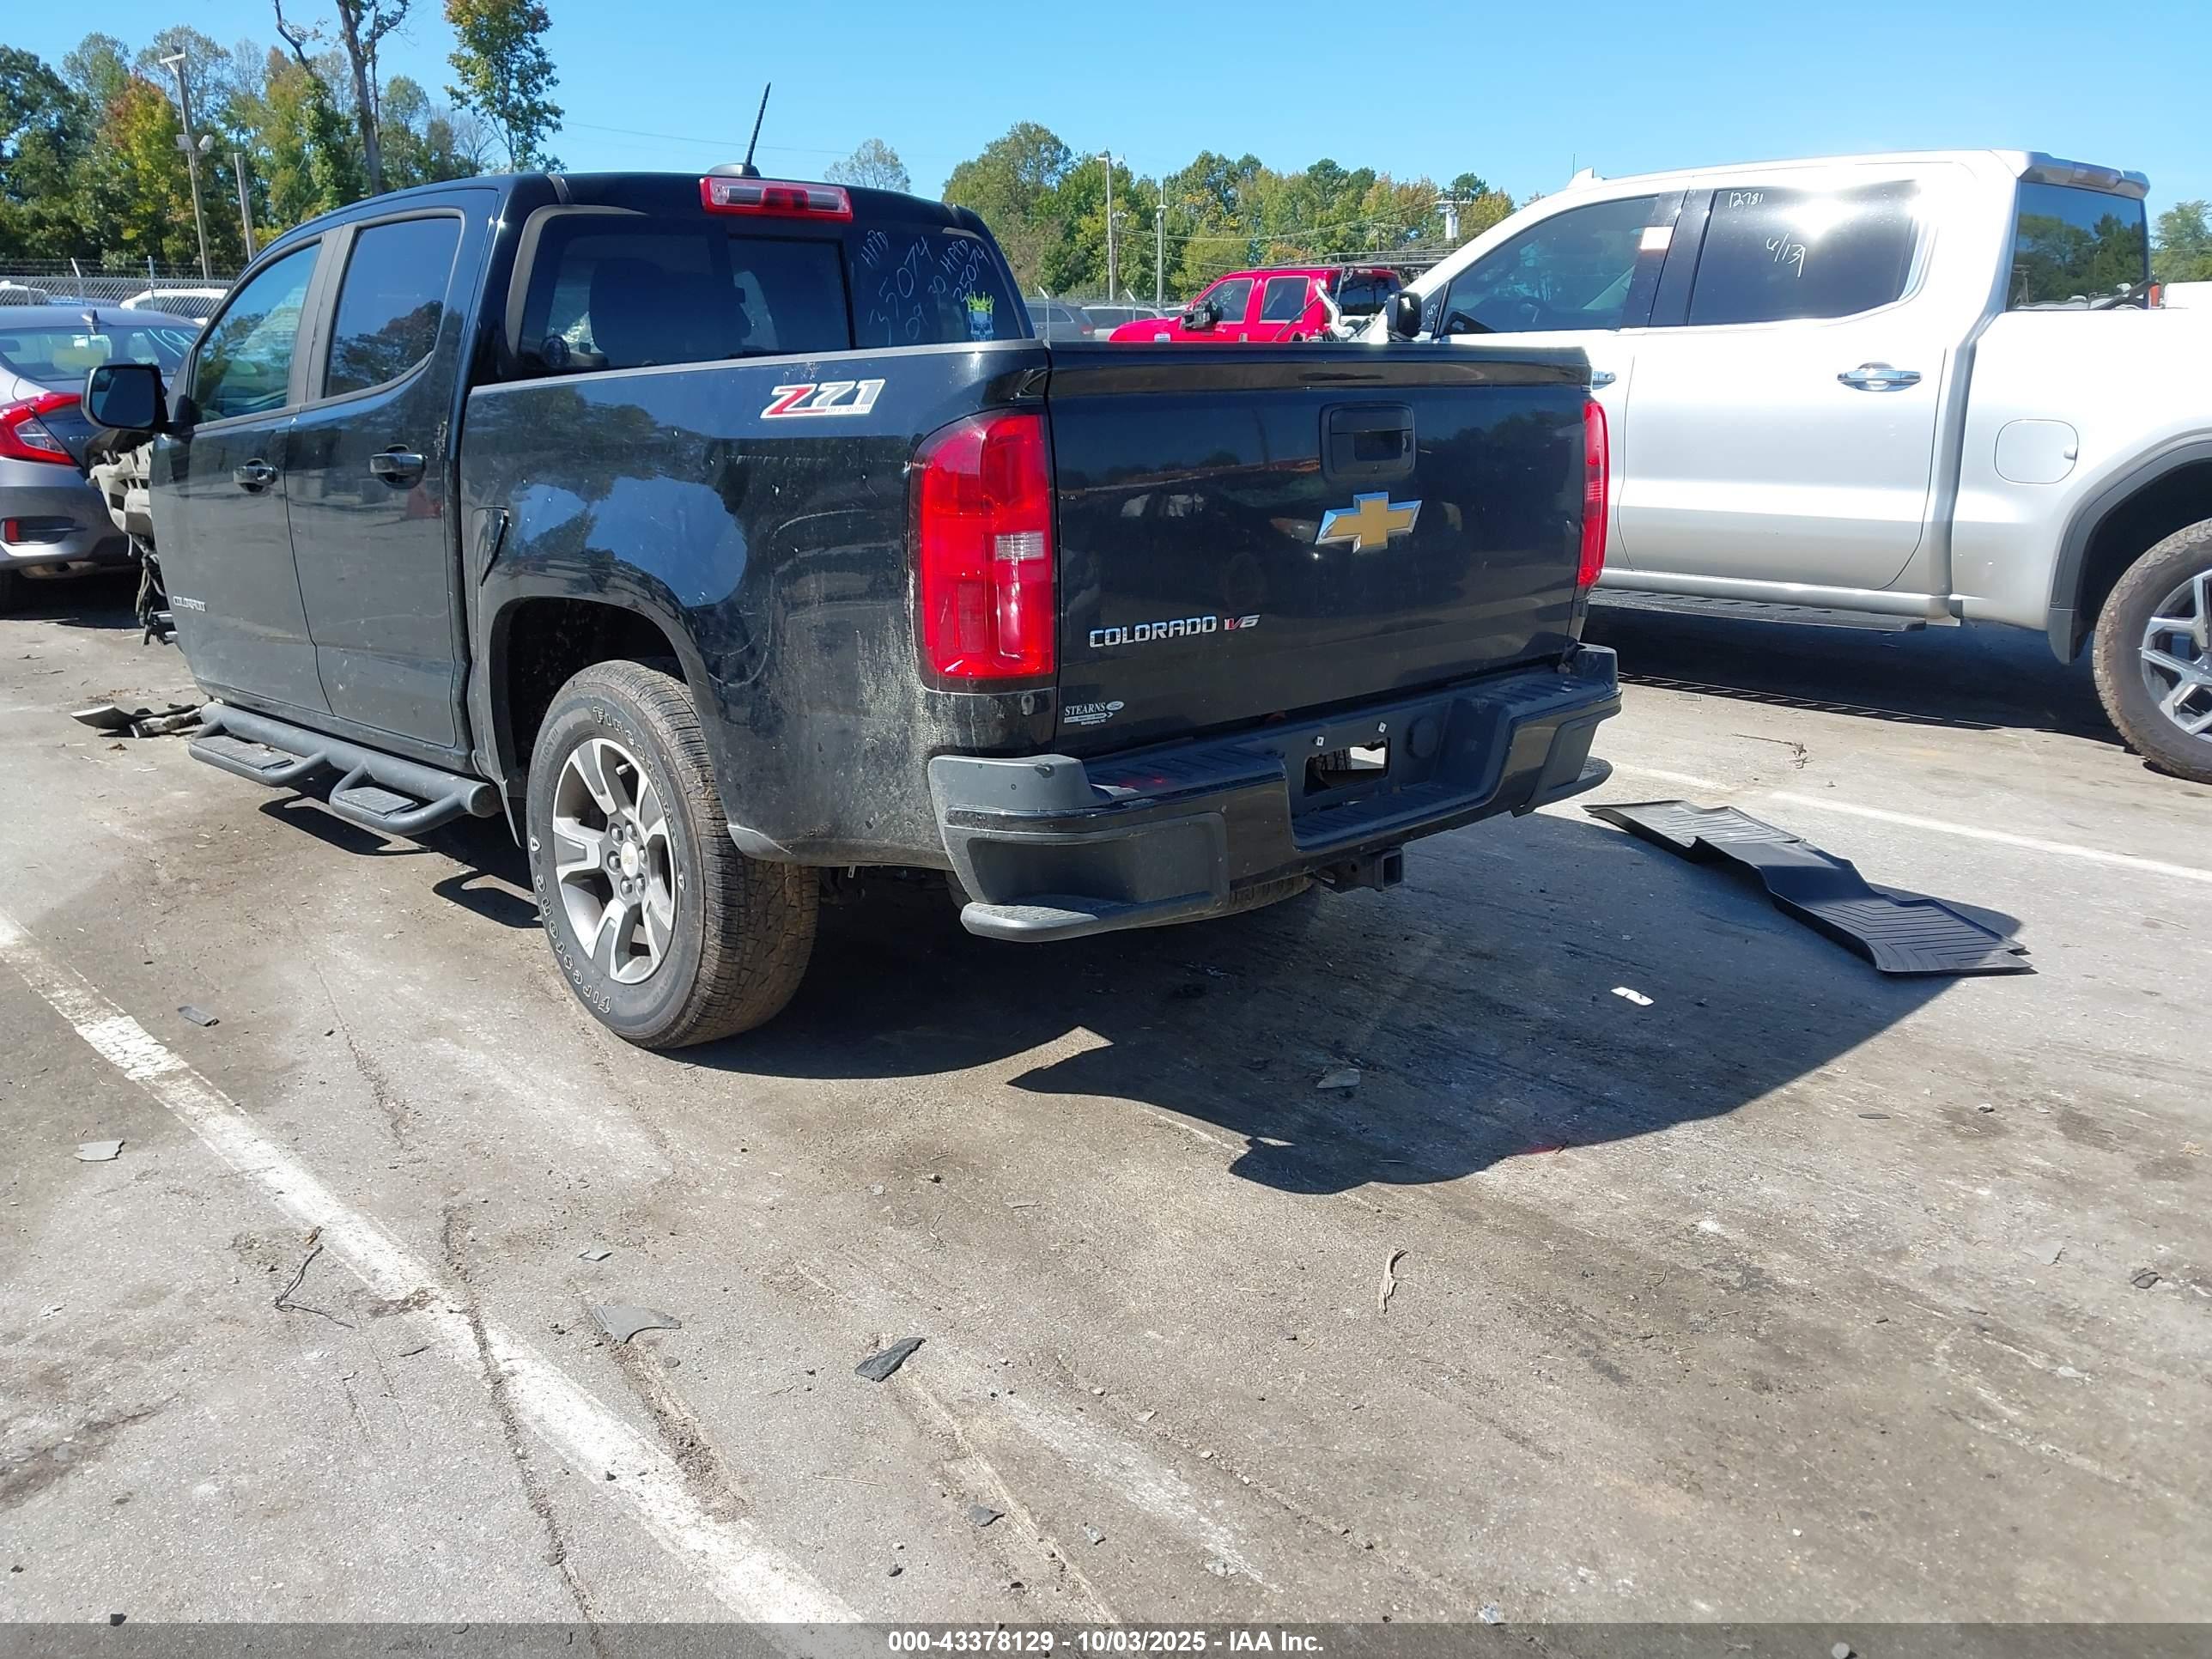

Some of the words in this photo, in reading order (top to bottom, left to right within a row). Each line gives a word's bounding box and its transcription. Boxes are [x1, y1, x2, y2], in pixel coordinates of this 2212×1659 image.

[1729, 191, 1764, 209] 12781
[759, 377, 886, 419] Z71
[1089, 616, 1217, 648] COLORADO
[1065, 702, 1106, 716] STEARNS
